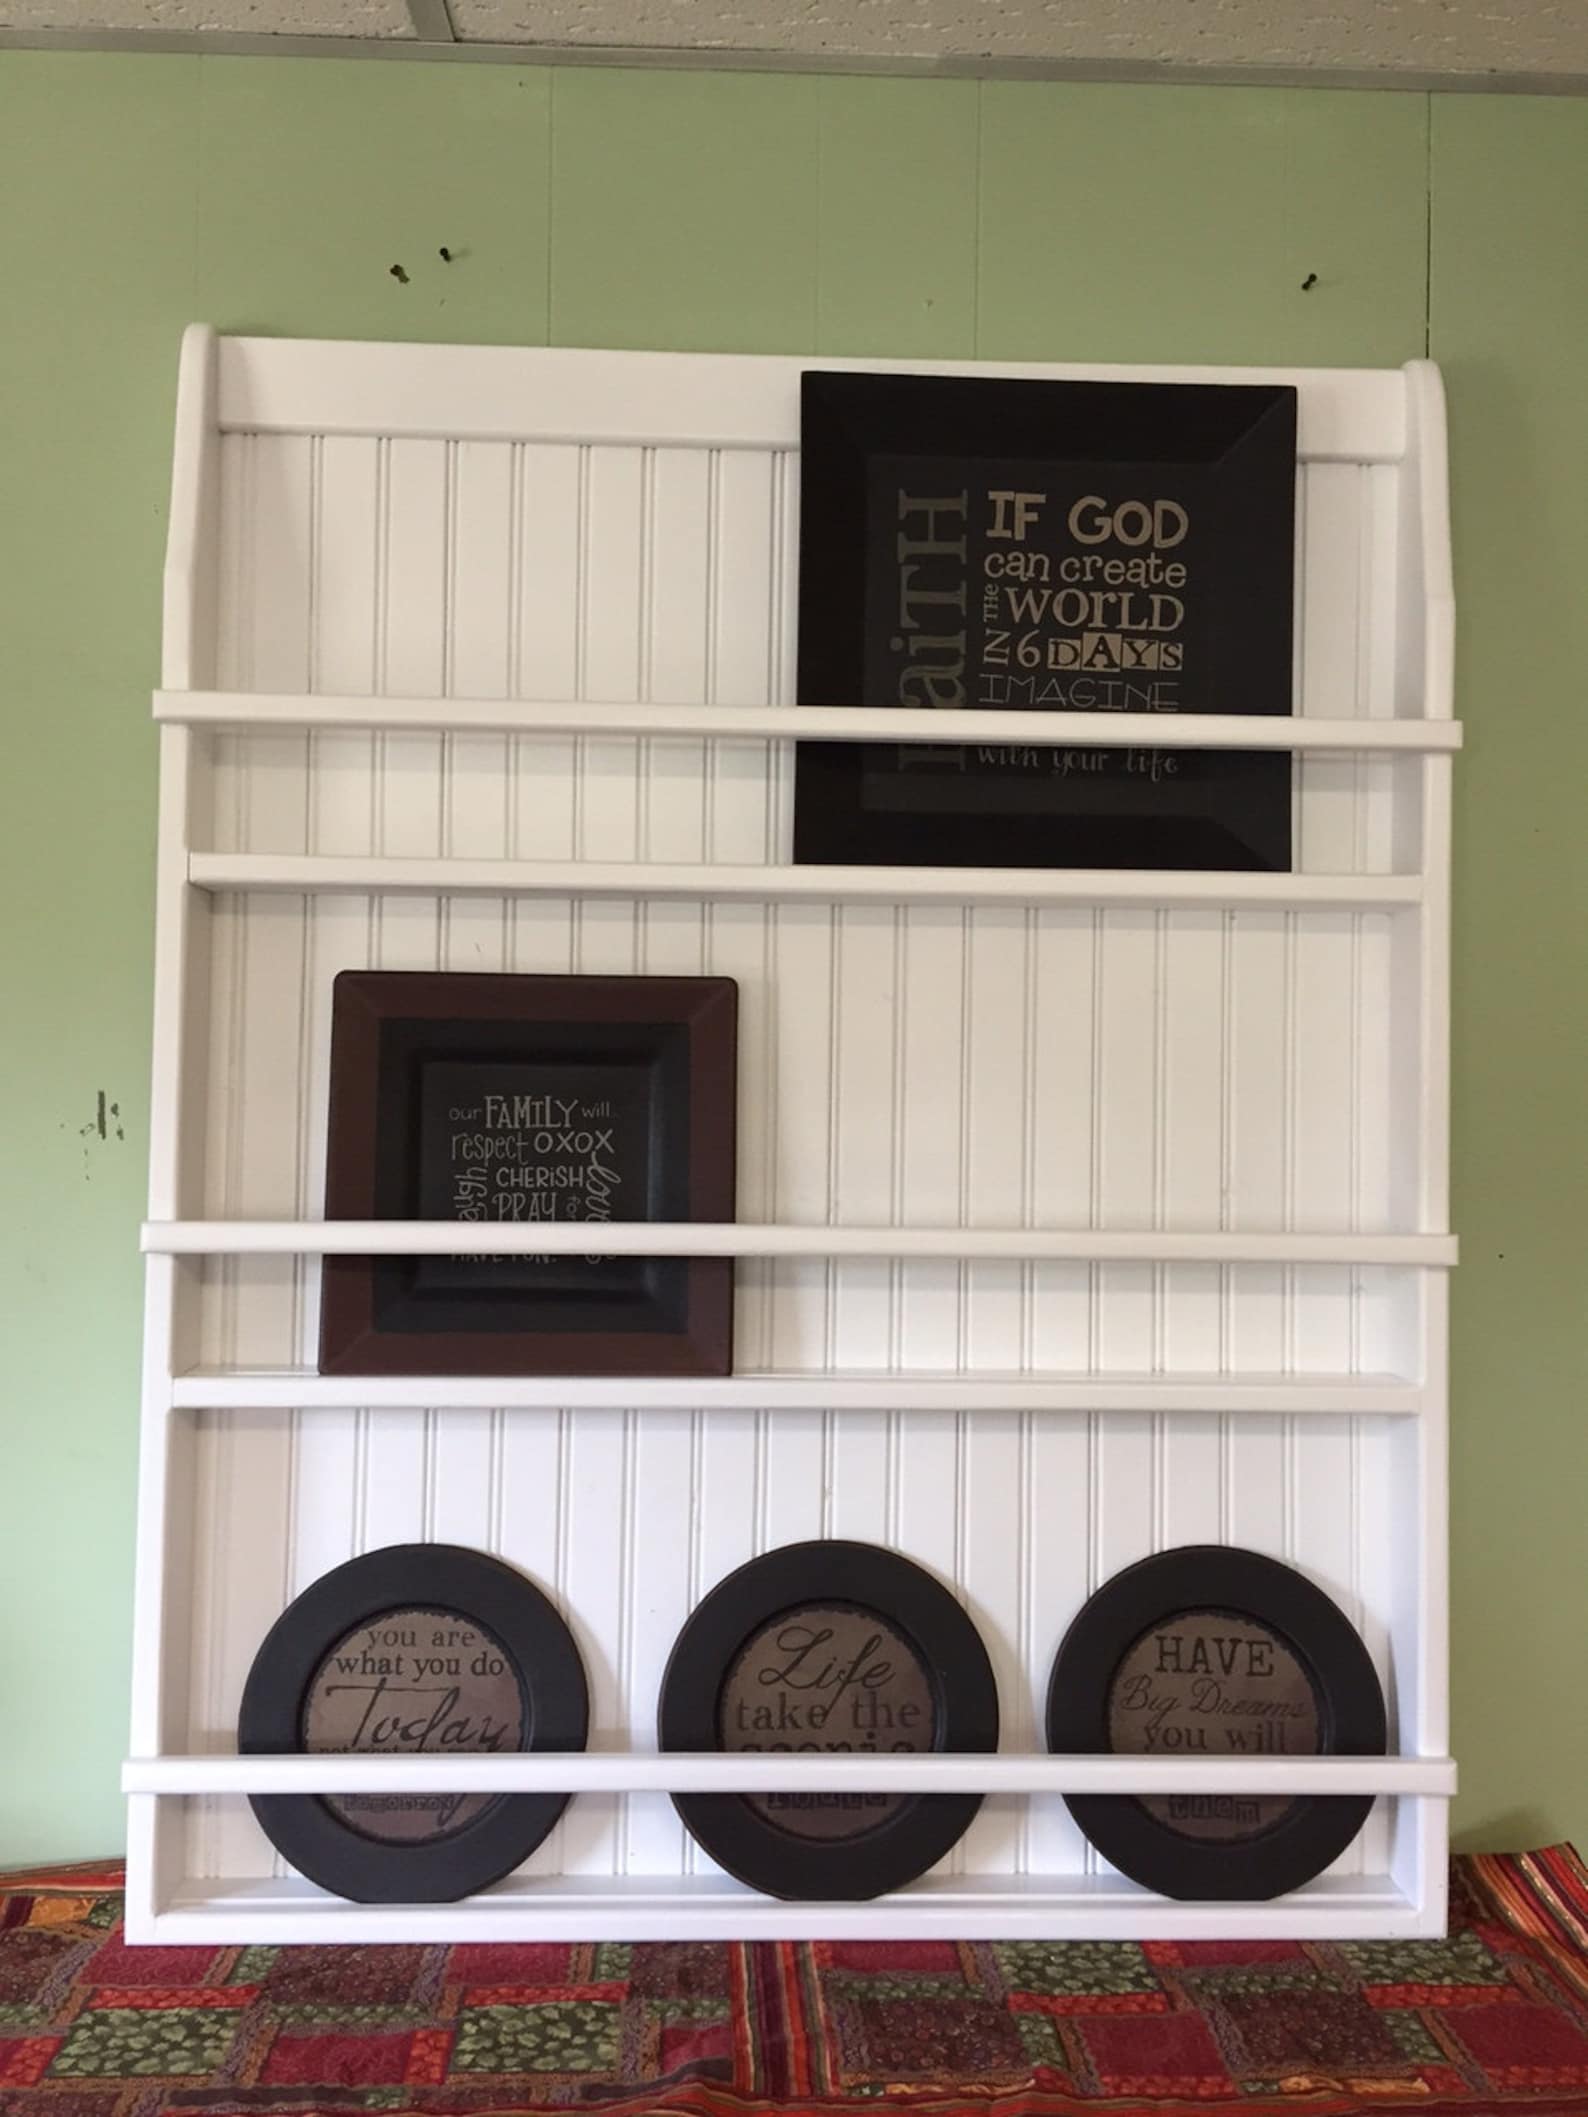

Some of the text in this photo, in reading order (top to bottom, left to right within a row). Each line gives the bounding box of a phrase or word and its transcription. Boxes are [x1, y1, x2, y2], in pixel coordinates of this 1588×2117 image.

[985, 490, 1189, 549] IF GOD
[984, 551, 1187, 588] can create
[983, 628, 1012, 665] IN
[1016, 629, 1041, 668] 6
[1047, 631, 1183, 672] DAYS
[978, 673, 1180, 712] IMAGINE
[977, 747, 1179, 782] with your life
[449, 1106, 482, 1121] our
[581, 1101, 611, 1119] will
[451, 1131, 529, 1168] respect
[452, 1166, 488, 1222] augh
[367, 1629, 476, 1650] you are
[1154, 1635, 1275, 1677] HAVE
[336, 1650, 505, 1683] what you do
[757, 1625, 897, 1724] Life
[736, 1690, 921, 1732] take the
[1120, 1673, 1307, 1729] Big Dreams
[1143, 1720, 1286, 1753] you will
